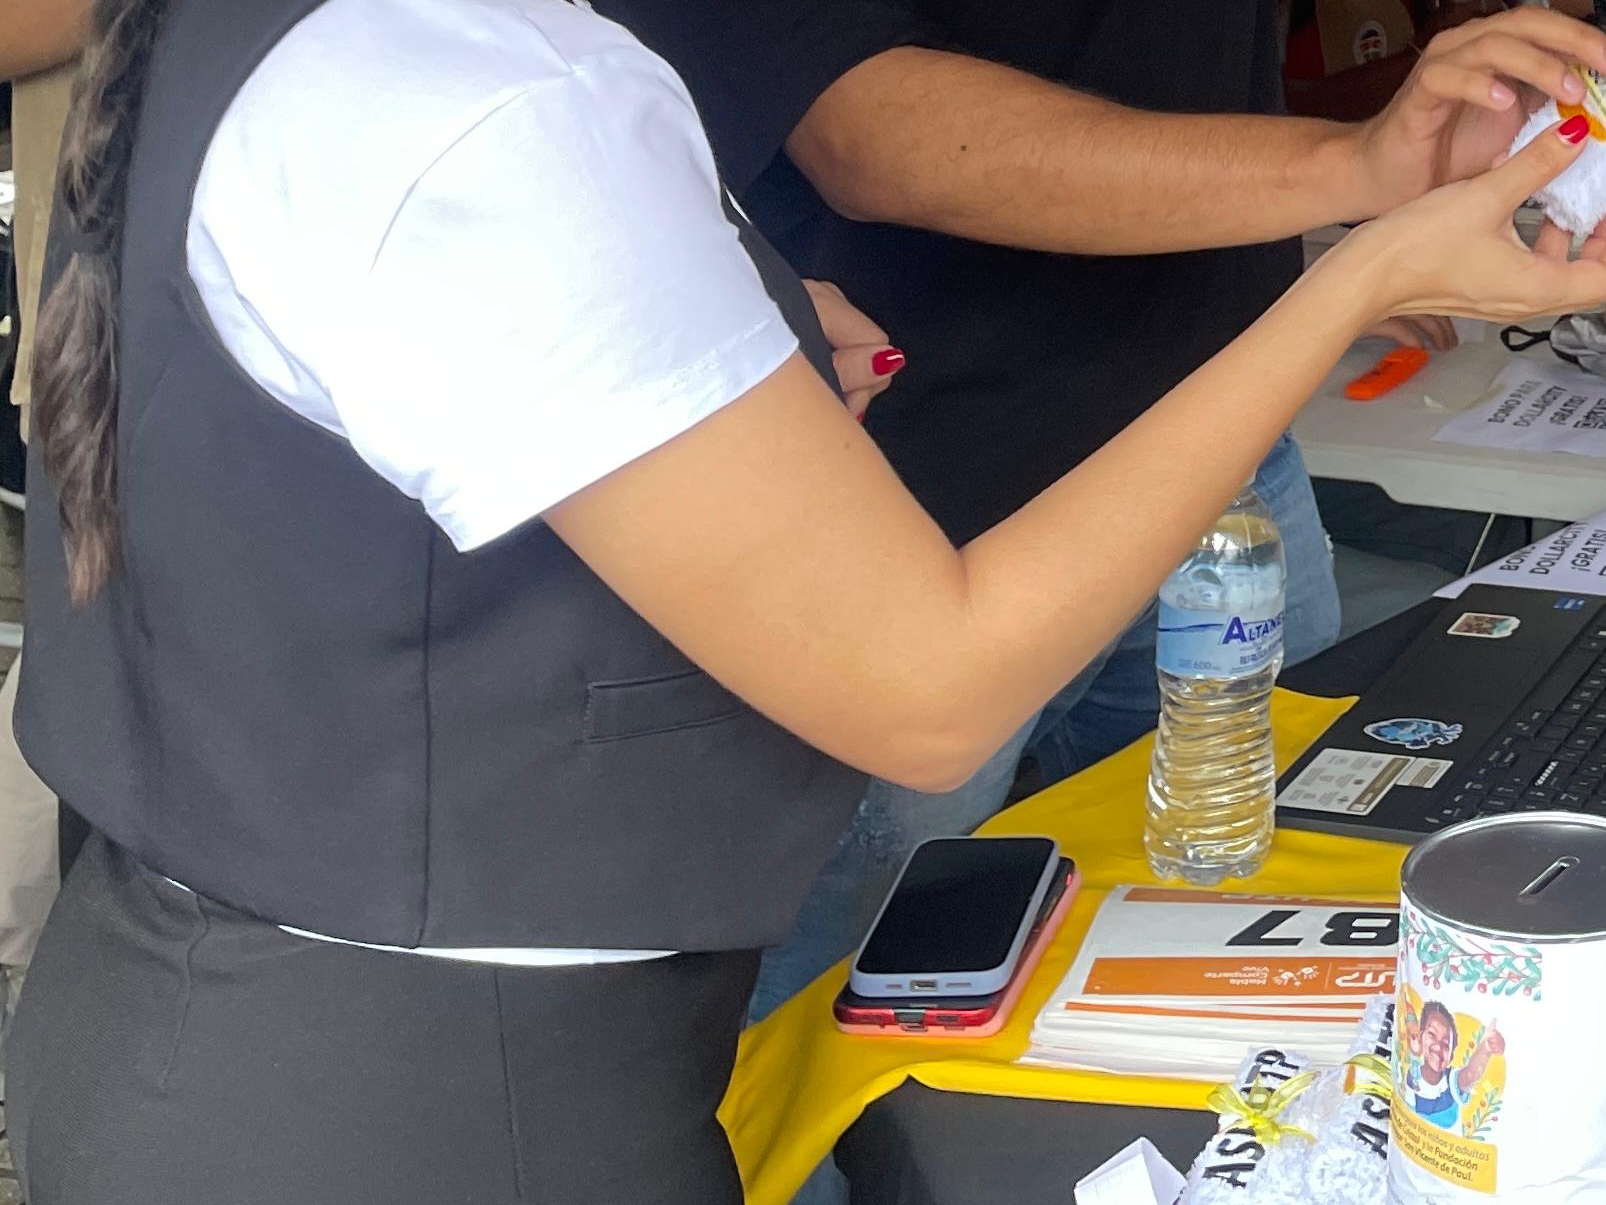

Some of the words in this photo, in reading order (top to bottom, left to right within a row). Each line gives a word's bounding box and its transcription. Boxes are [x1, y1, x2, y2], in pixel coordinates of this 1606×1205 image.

[1225, 910, 1400, 947] 87
[1434, 1146, 1479, 1172] Fundación
[1455, 1145, 1490, 1162] adultos
